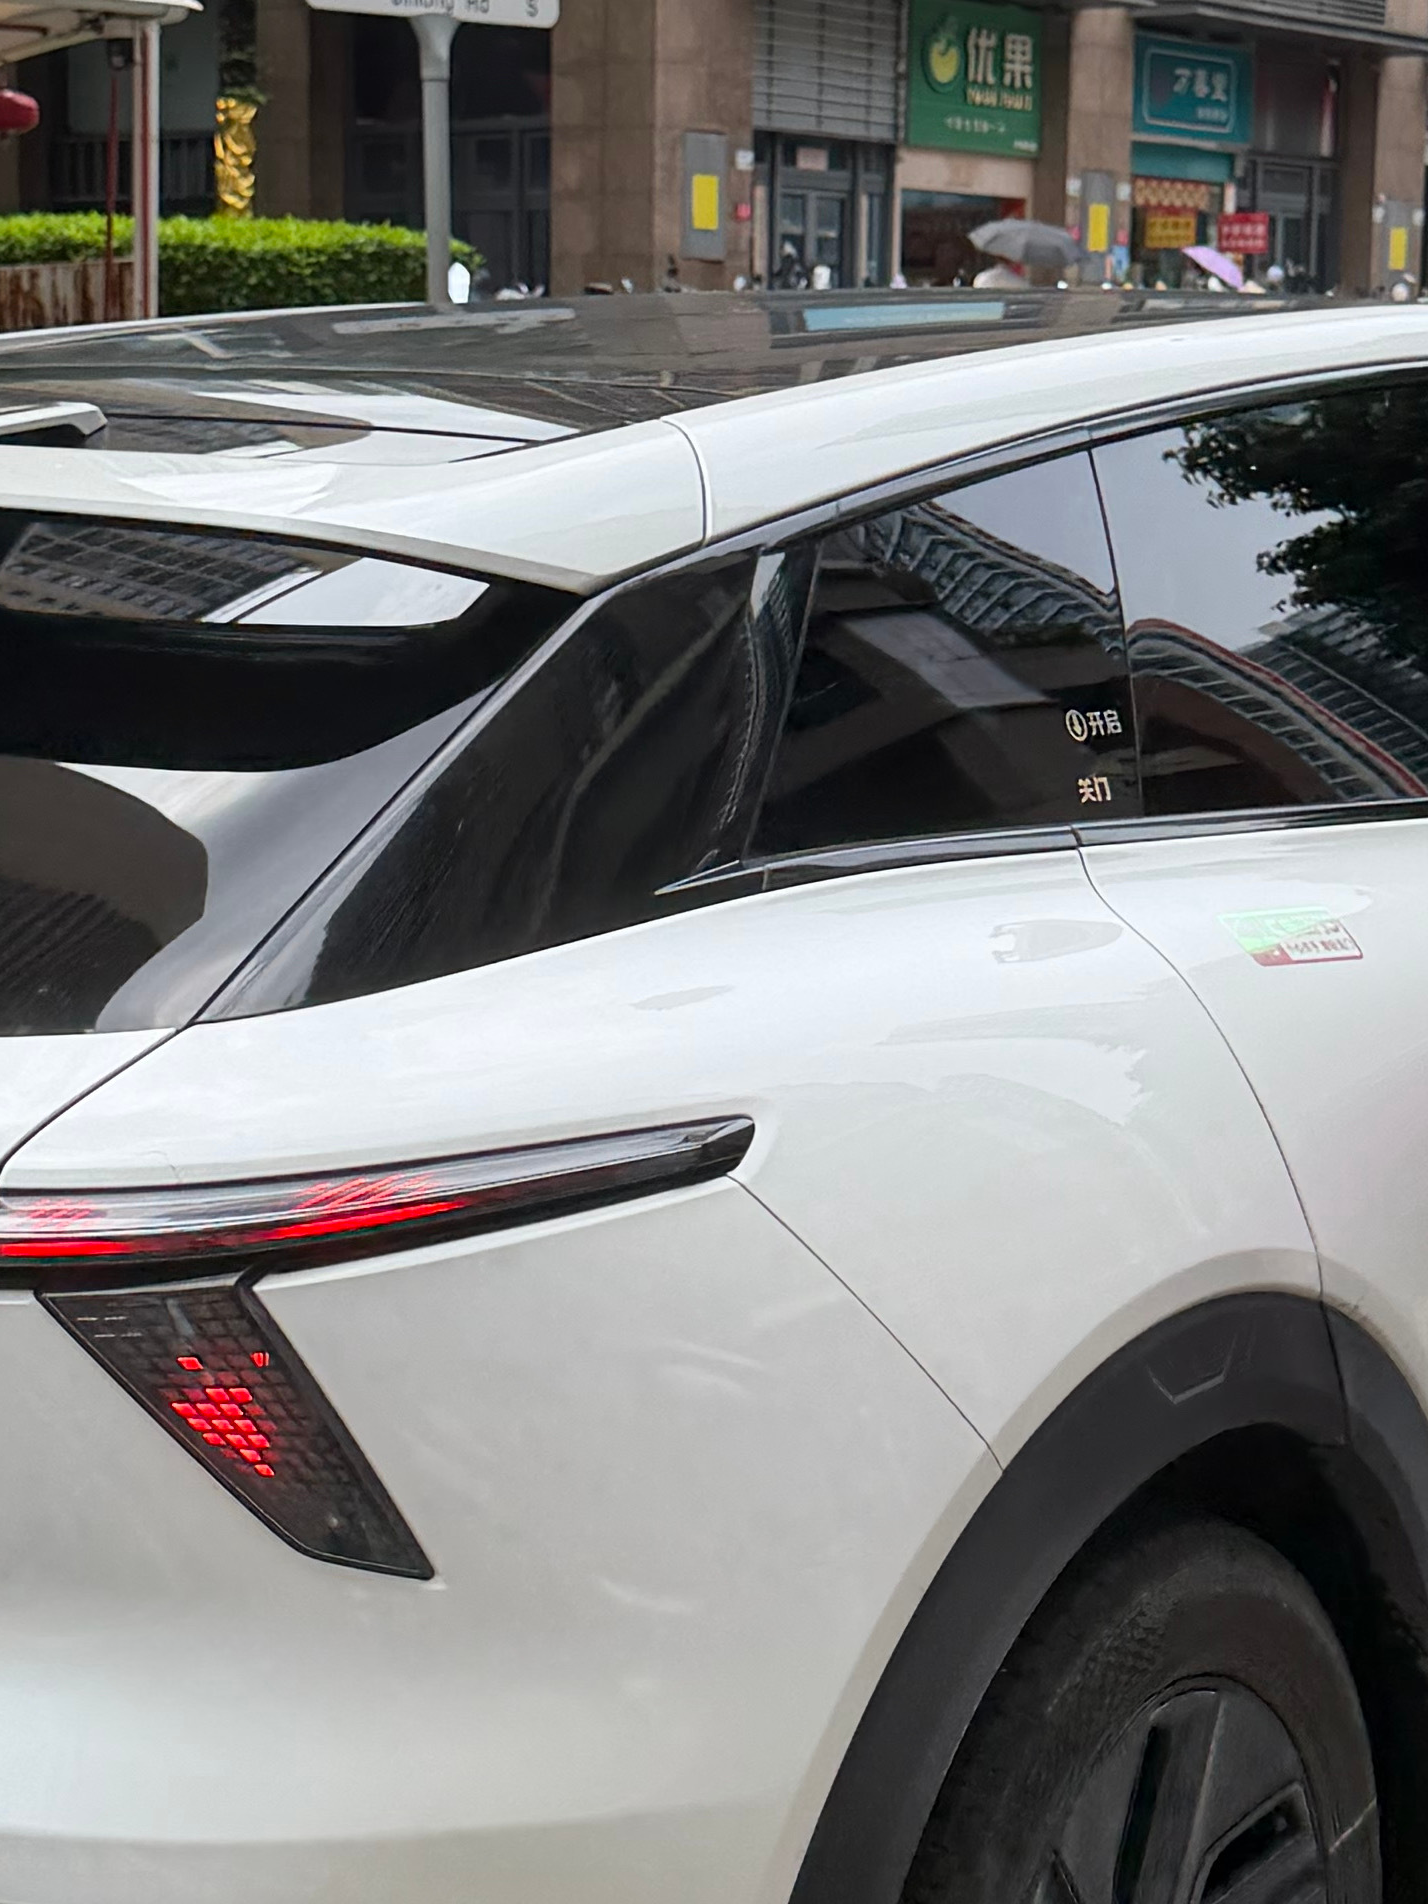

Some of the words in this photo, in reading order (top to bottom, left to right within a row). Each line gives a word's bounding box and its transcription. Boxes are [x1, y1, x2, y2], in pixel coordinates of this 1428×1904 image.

[967, 27, 1033, 90] 优果
[1086, 709, 1123, 736] 开启
[1077, 774, 1112, 803] 关门
